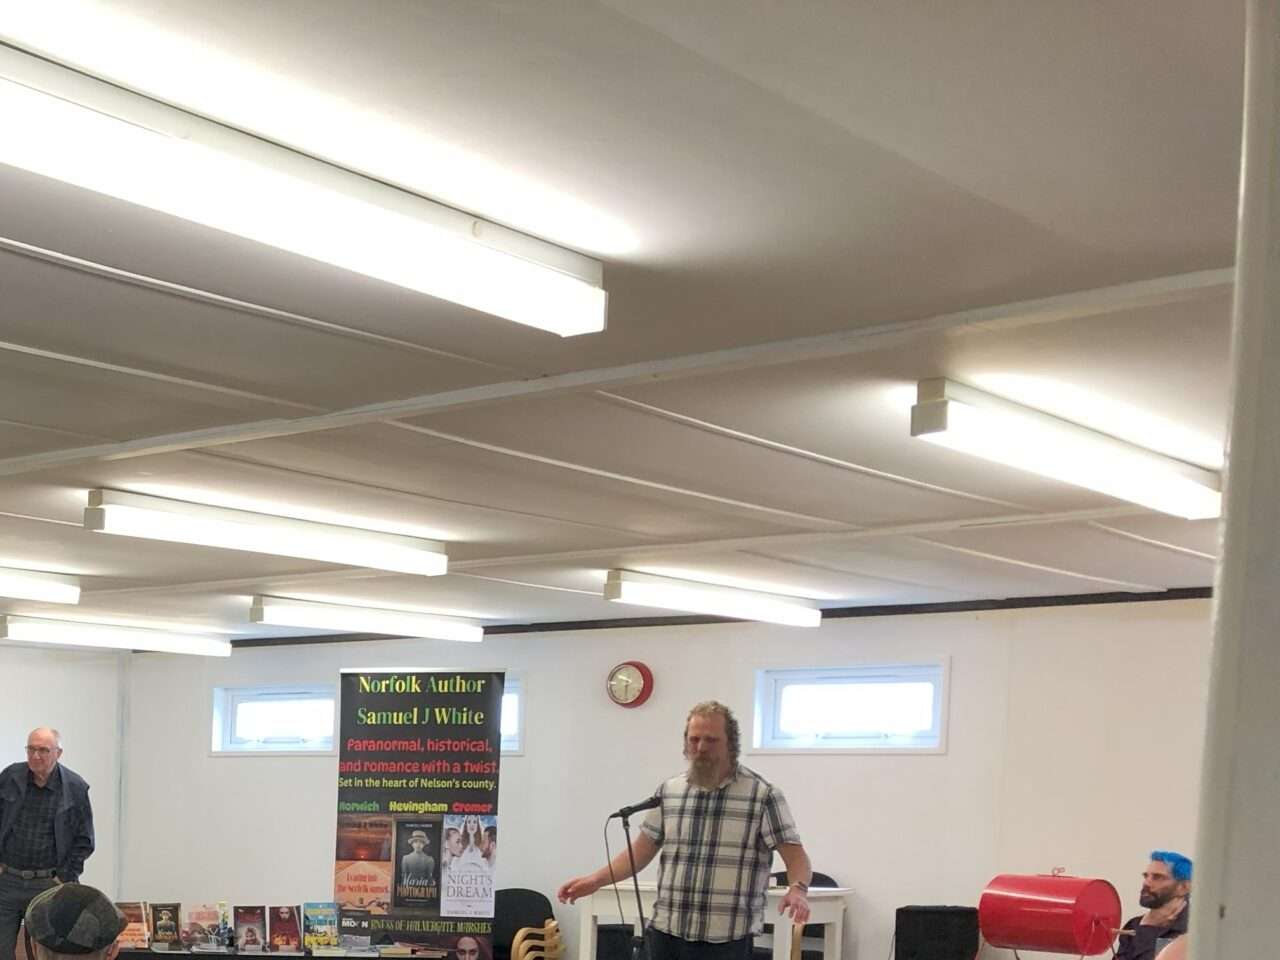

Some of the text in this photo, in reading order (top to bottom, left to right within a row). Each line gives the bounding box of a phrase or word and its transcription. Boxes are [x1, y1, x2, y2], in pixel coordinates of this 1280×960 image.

[359, 675, 486, 694] Norfolk Author
[357, 707, 484, 725] Samuel J White
[340, 760, 361, 772] and
[363, 761, 420, 773] romance
[421, 760, 450, 773] with
[452, 763, 461, 773] a
[338, 777, 353, 787] Set
[354, 777, 363, 787] in
[368, 777, 381, 787] the
[382, 777, 407, 788] heart
[408, 778, 419, 788] of
[461, 779, 497, 791] county.
[446, 886, 493, 898] DREAM
